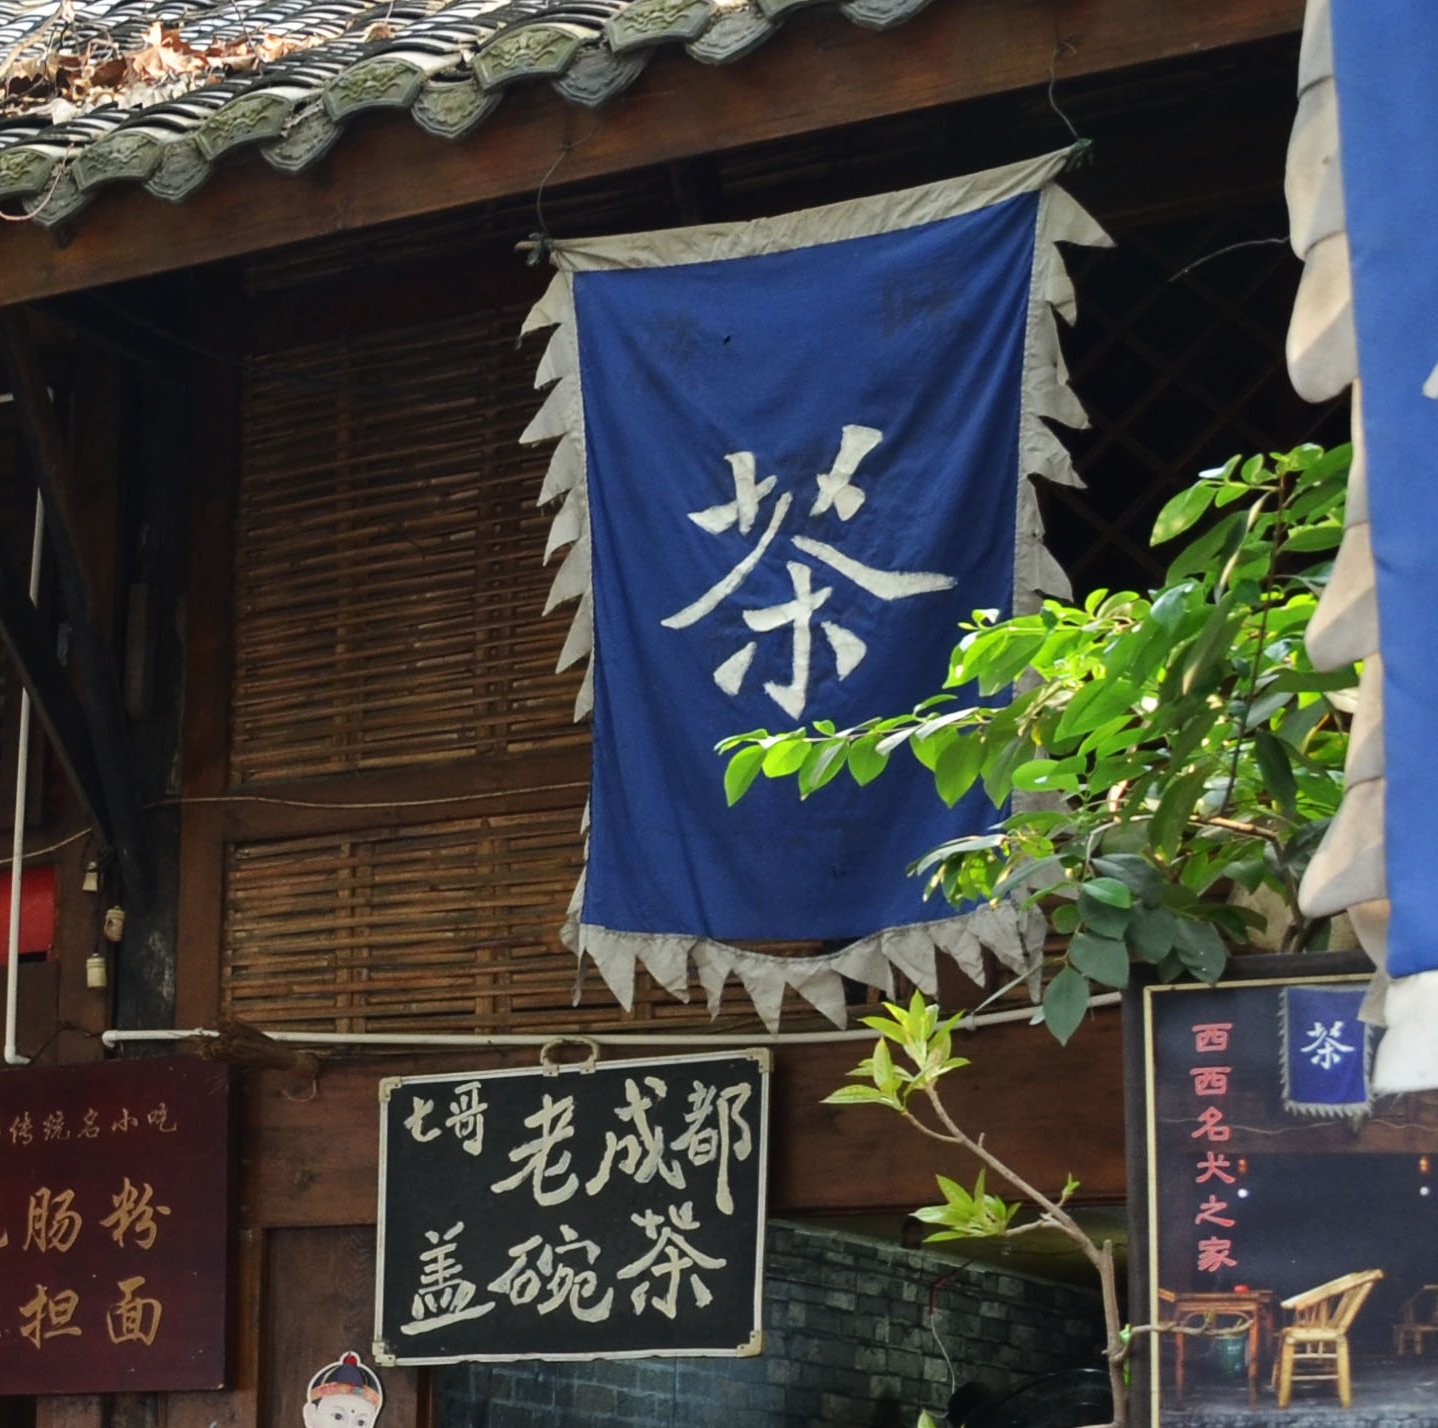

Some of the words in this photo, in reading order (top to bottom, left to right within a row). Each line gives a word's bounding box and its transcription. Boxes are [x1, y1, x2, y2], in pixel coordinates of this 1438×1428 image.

[660, 424, 958, 721] 茶
[1300, 1020, 1356, 1070] 茶
[1189, 1022, 1237, 1272] 西西名犬之家
[400, 1200, 728, 1336] 盖碗茶
